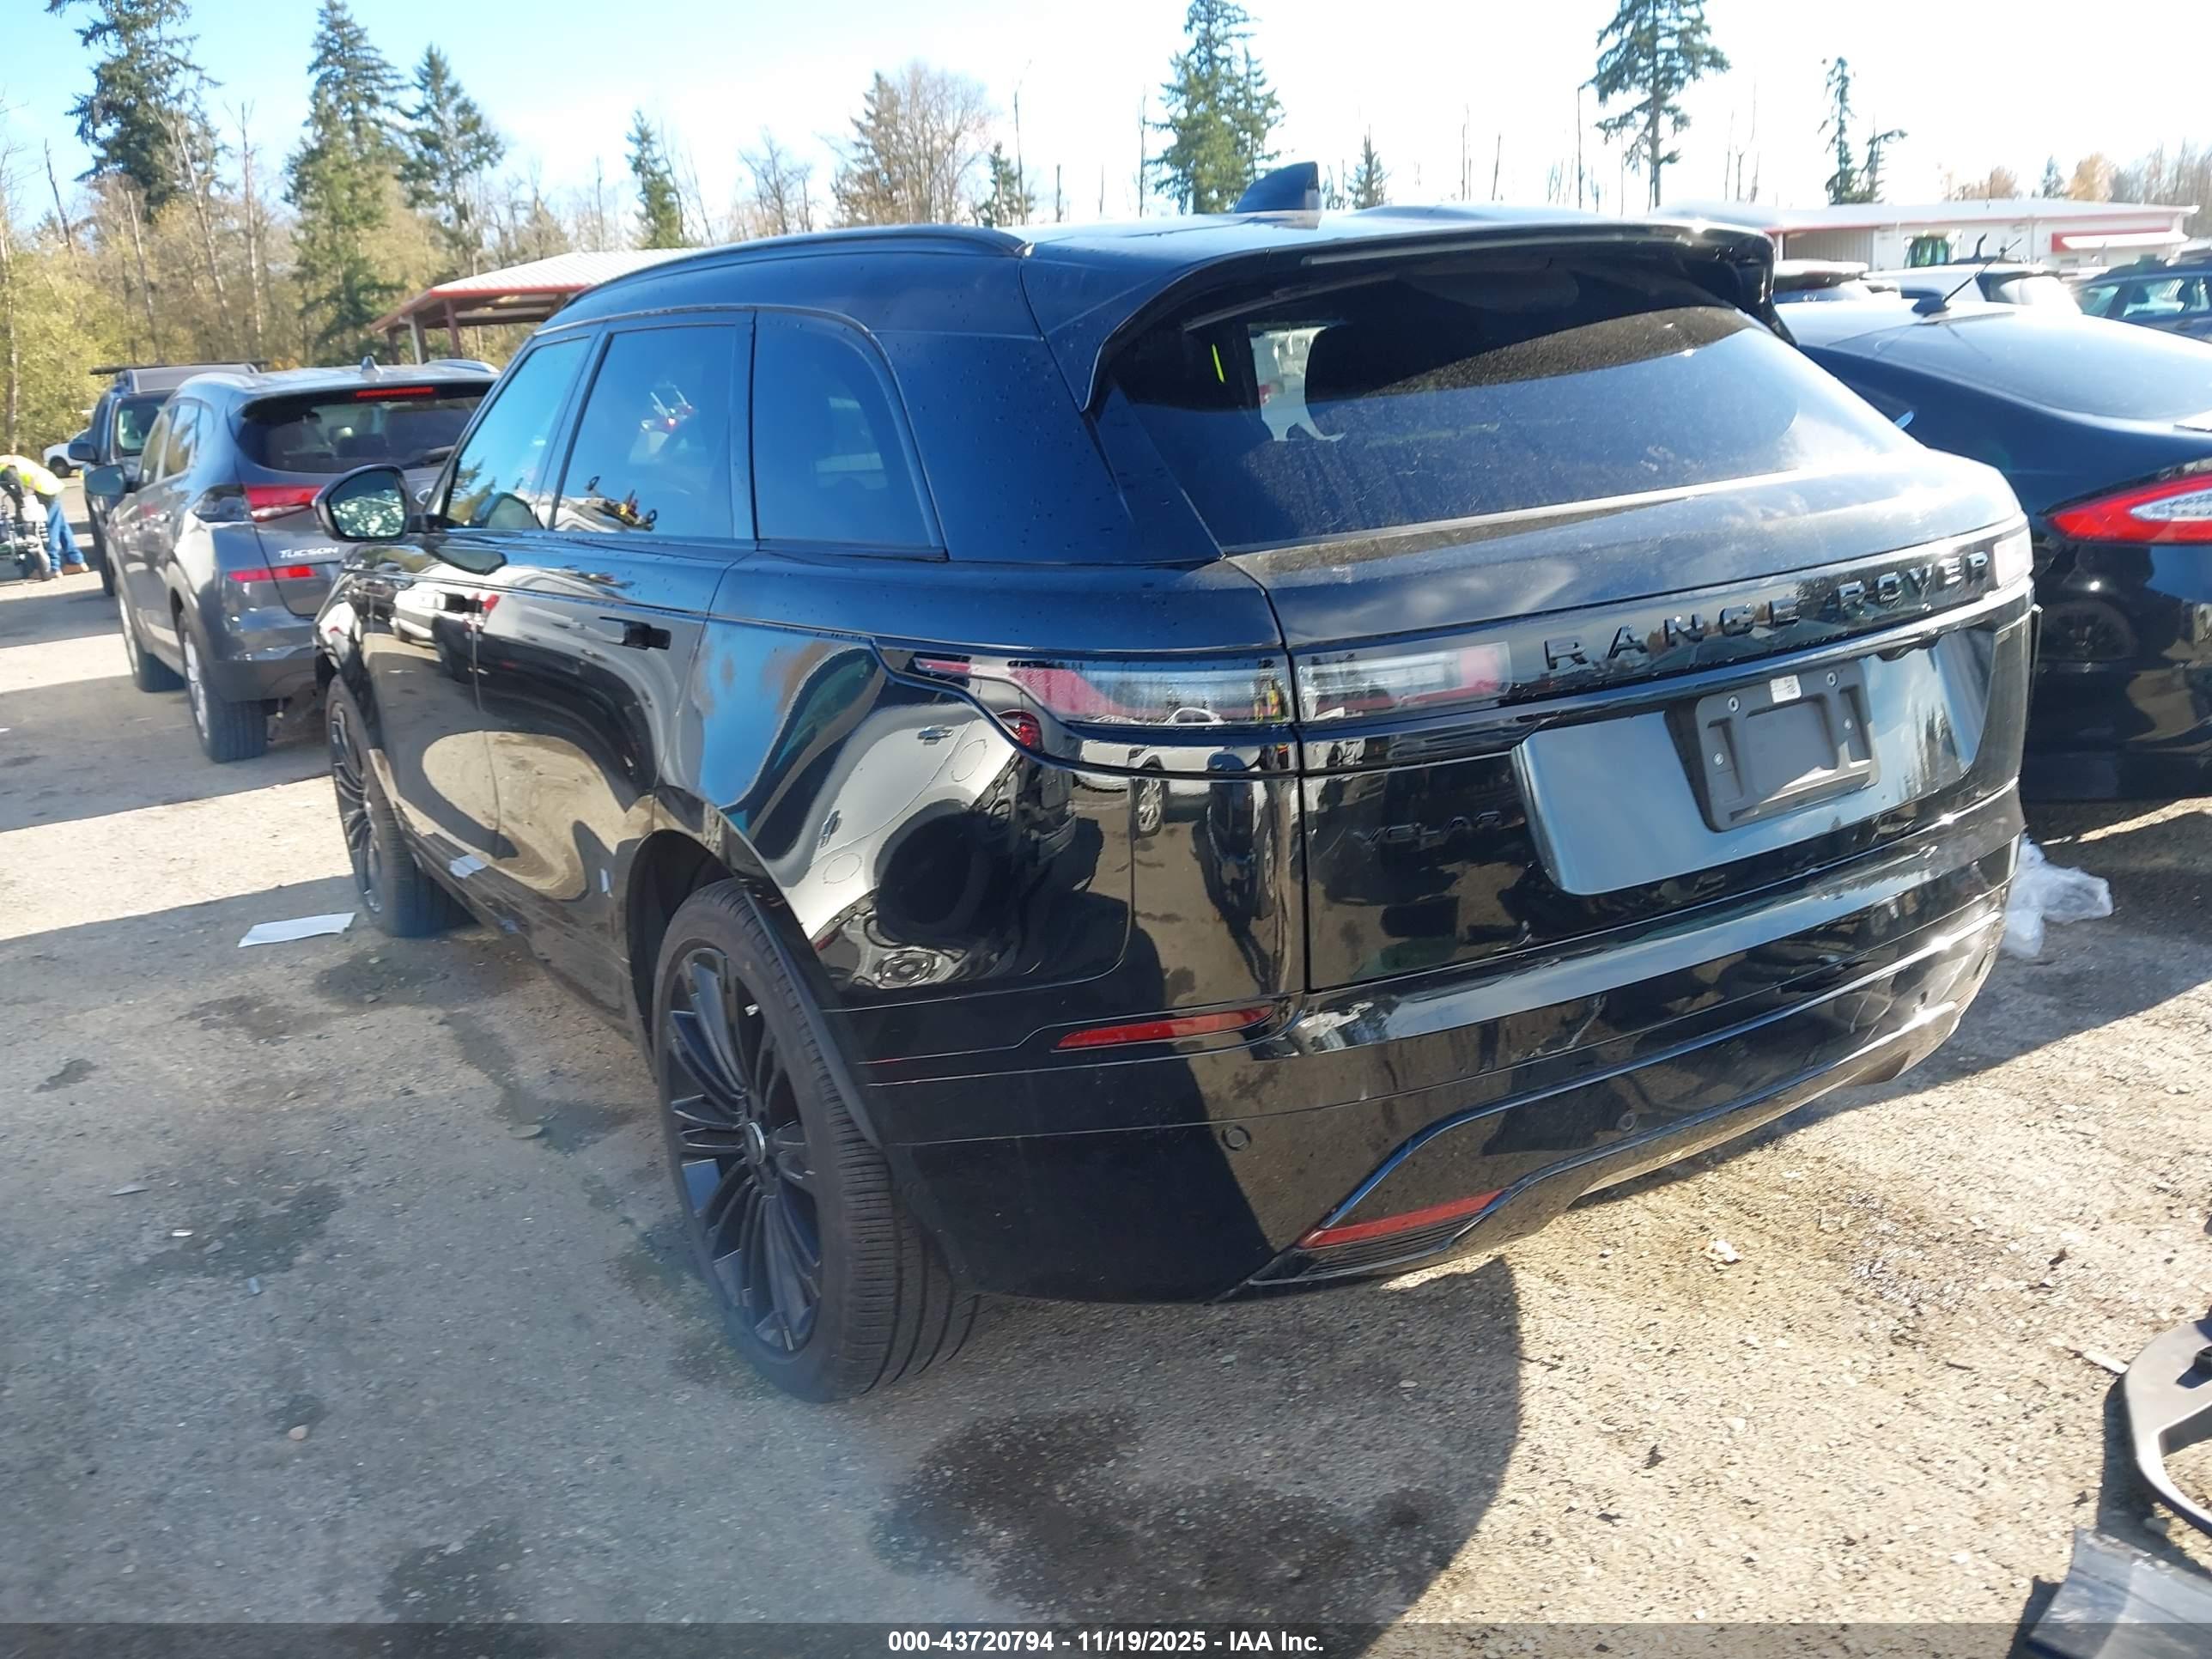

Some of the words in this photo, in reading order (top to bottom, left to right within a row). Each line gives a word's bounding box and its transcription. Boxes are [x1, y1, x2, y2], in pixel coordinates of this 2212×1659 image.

[277, 547, 339, 559] TUCSON
[1544, 597, 1801, 670] RANGE
[1836, 550, 1990, 616] ROVER
[1352, 810, 1502, 852] VELAR
